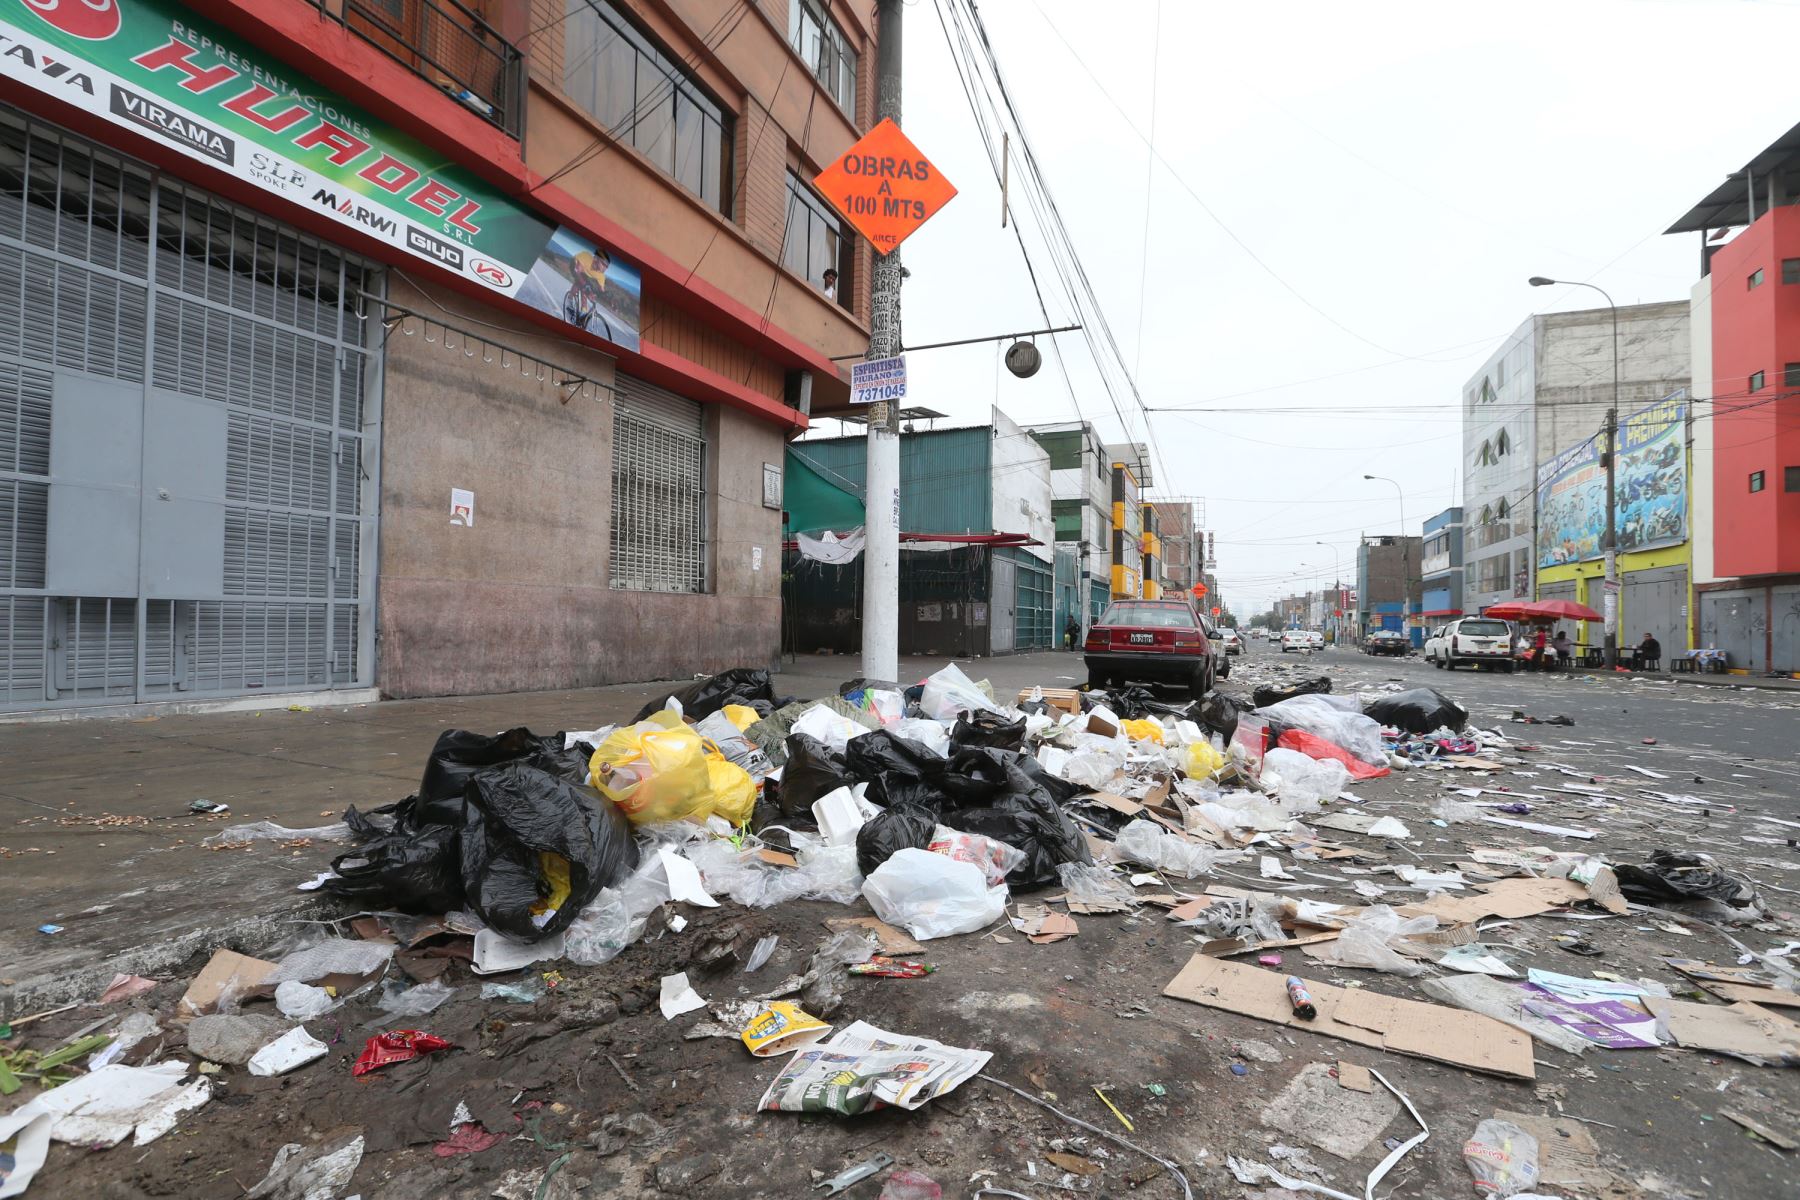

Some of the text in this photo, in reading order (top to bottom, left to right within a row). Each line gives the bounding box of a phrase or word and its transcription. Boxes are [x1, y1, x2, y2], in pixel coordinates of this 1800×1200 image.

[171, 19, 371, 139] REPRESENTACIONES
[119, 89, 228, 155] VIRAMA
[129, 34, 482, 236] HUADEL
[249, 168, 288, 191] SPOKE
[250, 152, 307, 188] SLE
[843, 154, 929, 181] OBRAS
[877, 180, 893, 196] A
[311, 188, 397, 238] MARWI
[844, 194, 926, 220] 100 MTS
[872, 234, 897, 244] ARCE
[853, 358, 904, 377] ESPIRITISTA
[853, 371, 892, 384] PIURANO
[858, 384, 906, 401] 7371045
